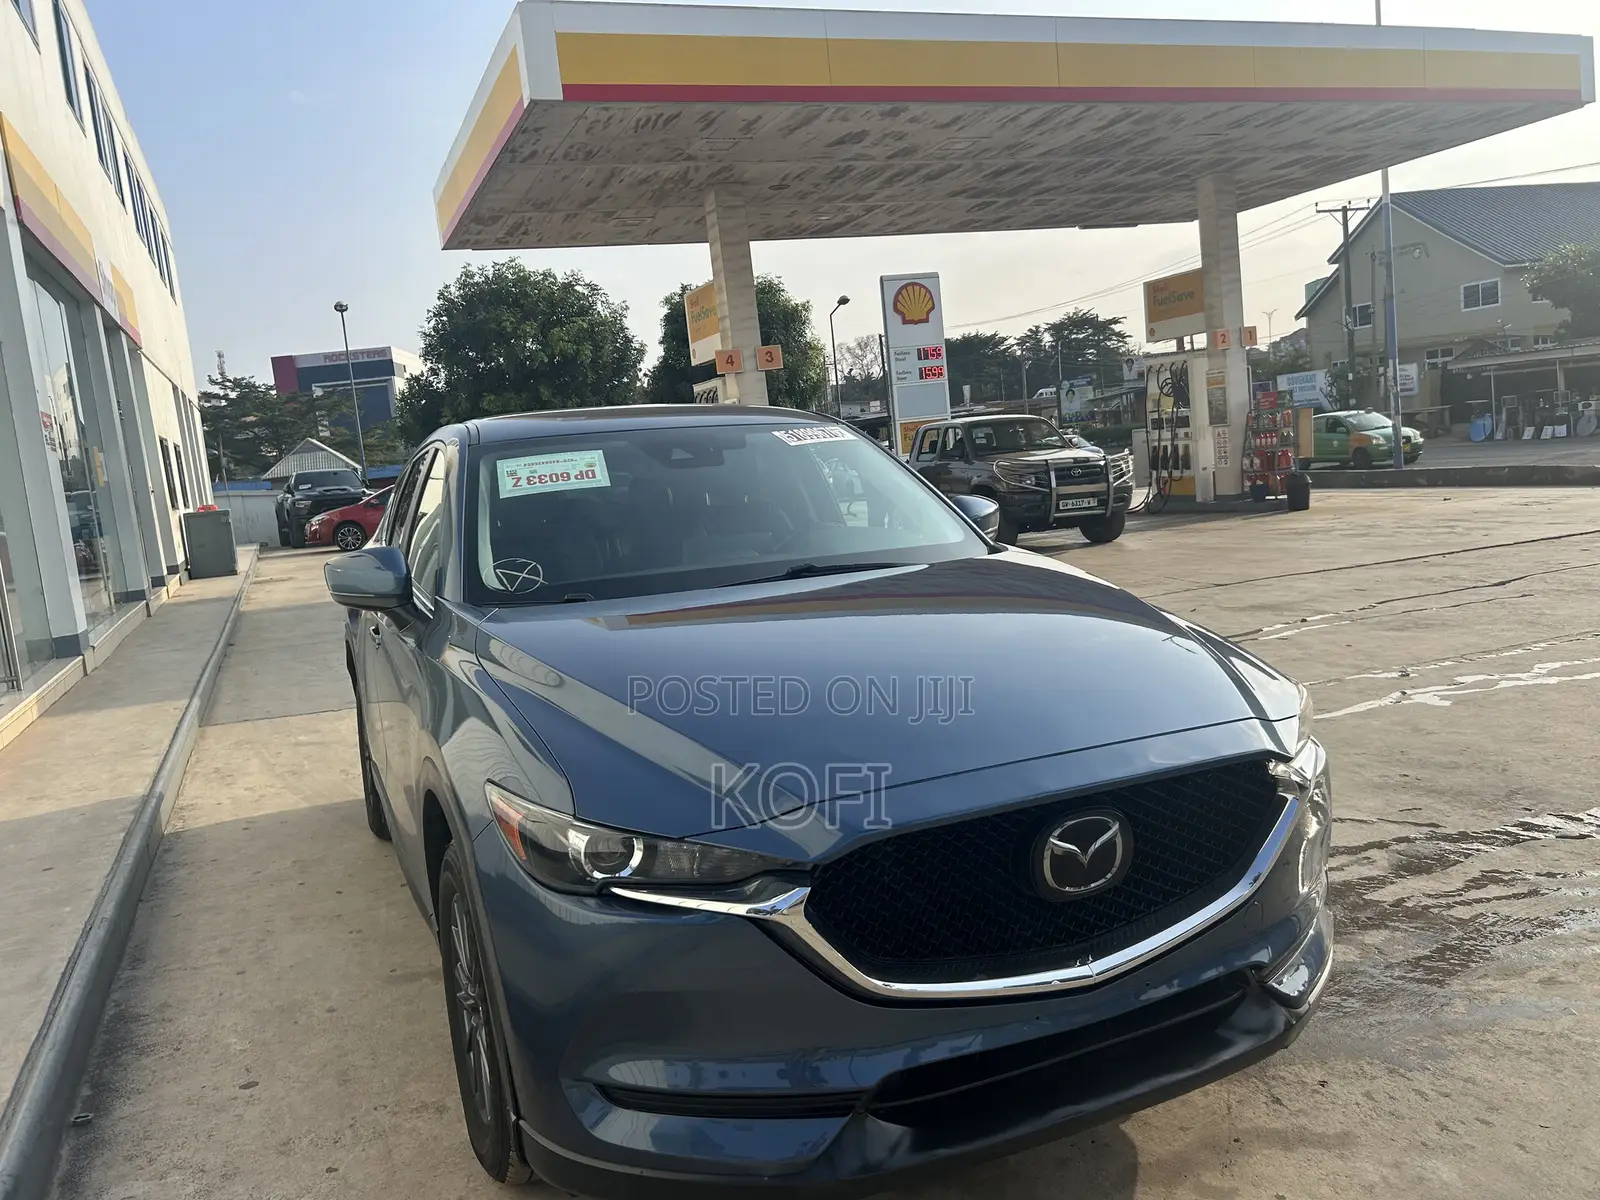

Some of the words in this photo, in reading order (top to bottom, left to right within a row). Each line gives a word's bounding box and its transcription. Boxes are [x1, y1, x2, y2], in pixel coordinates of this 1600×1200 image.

[1153, 290, 1196, 307] FuelSave
[1220, 334, 1227, 344] 2
[1248, 331, 1253, 341] 1
[725, 354, 735, 366] 4
[765, 351, 774, 363] 3
[526, 471, 571, 486] 6033
[575, 469, 597, 481] DP
